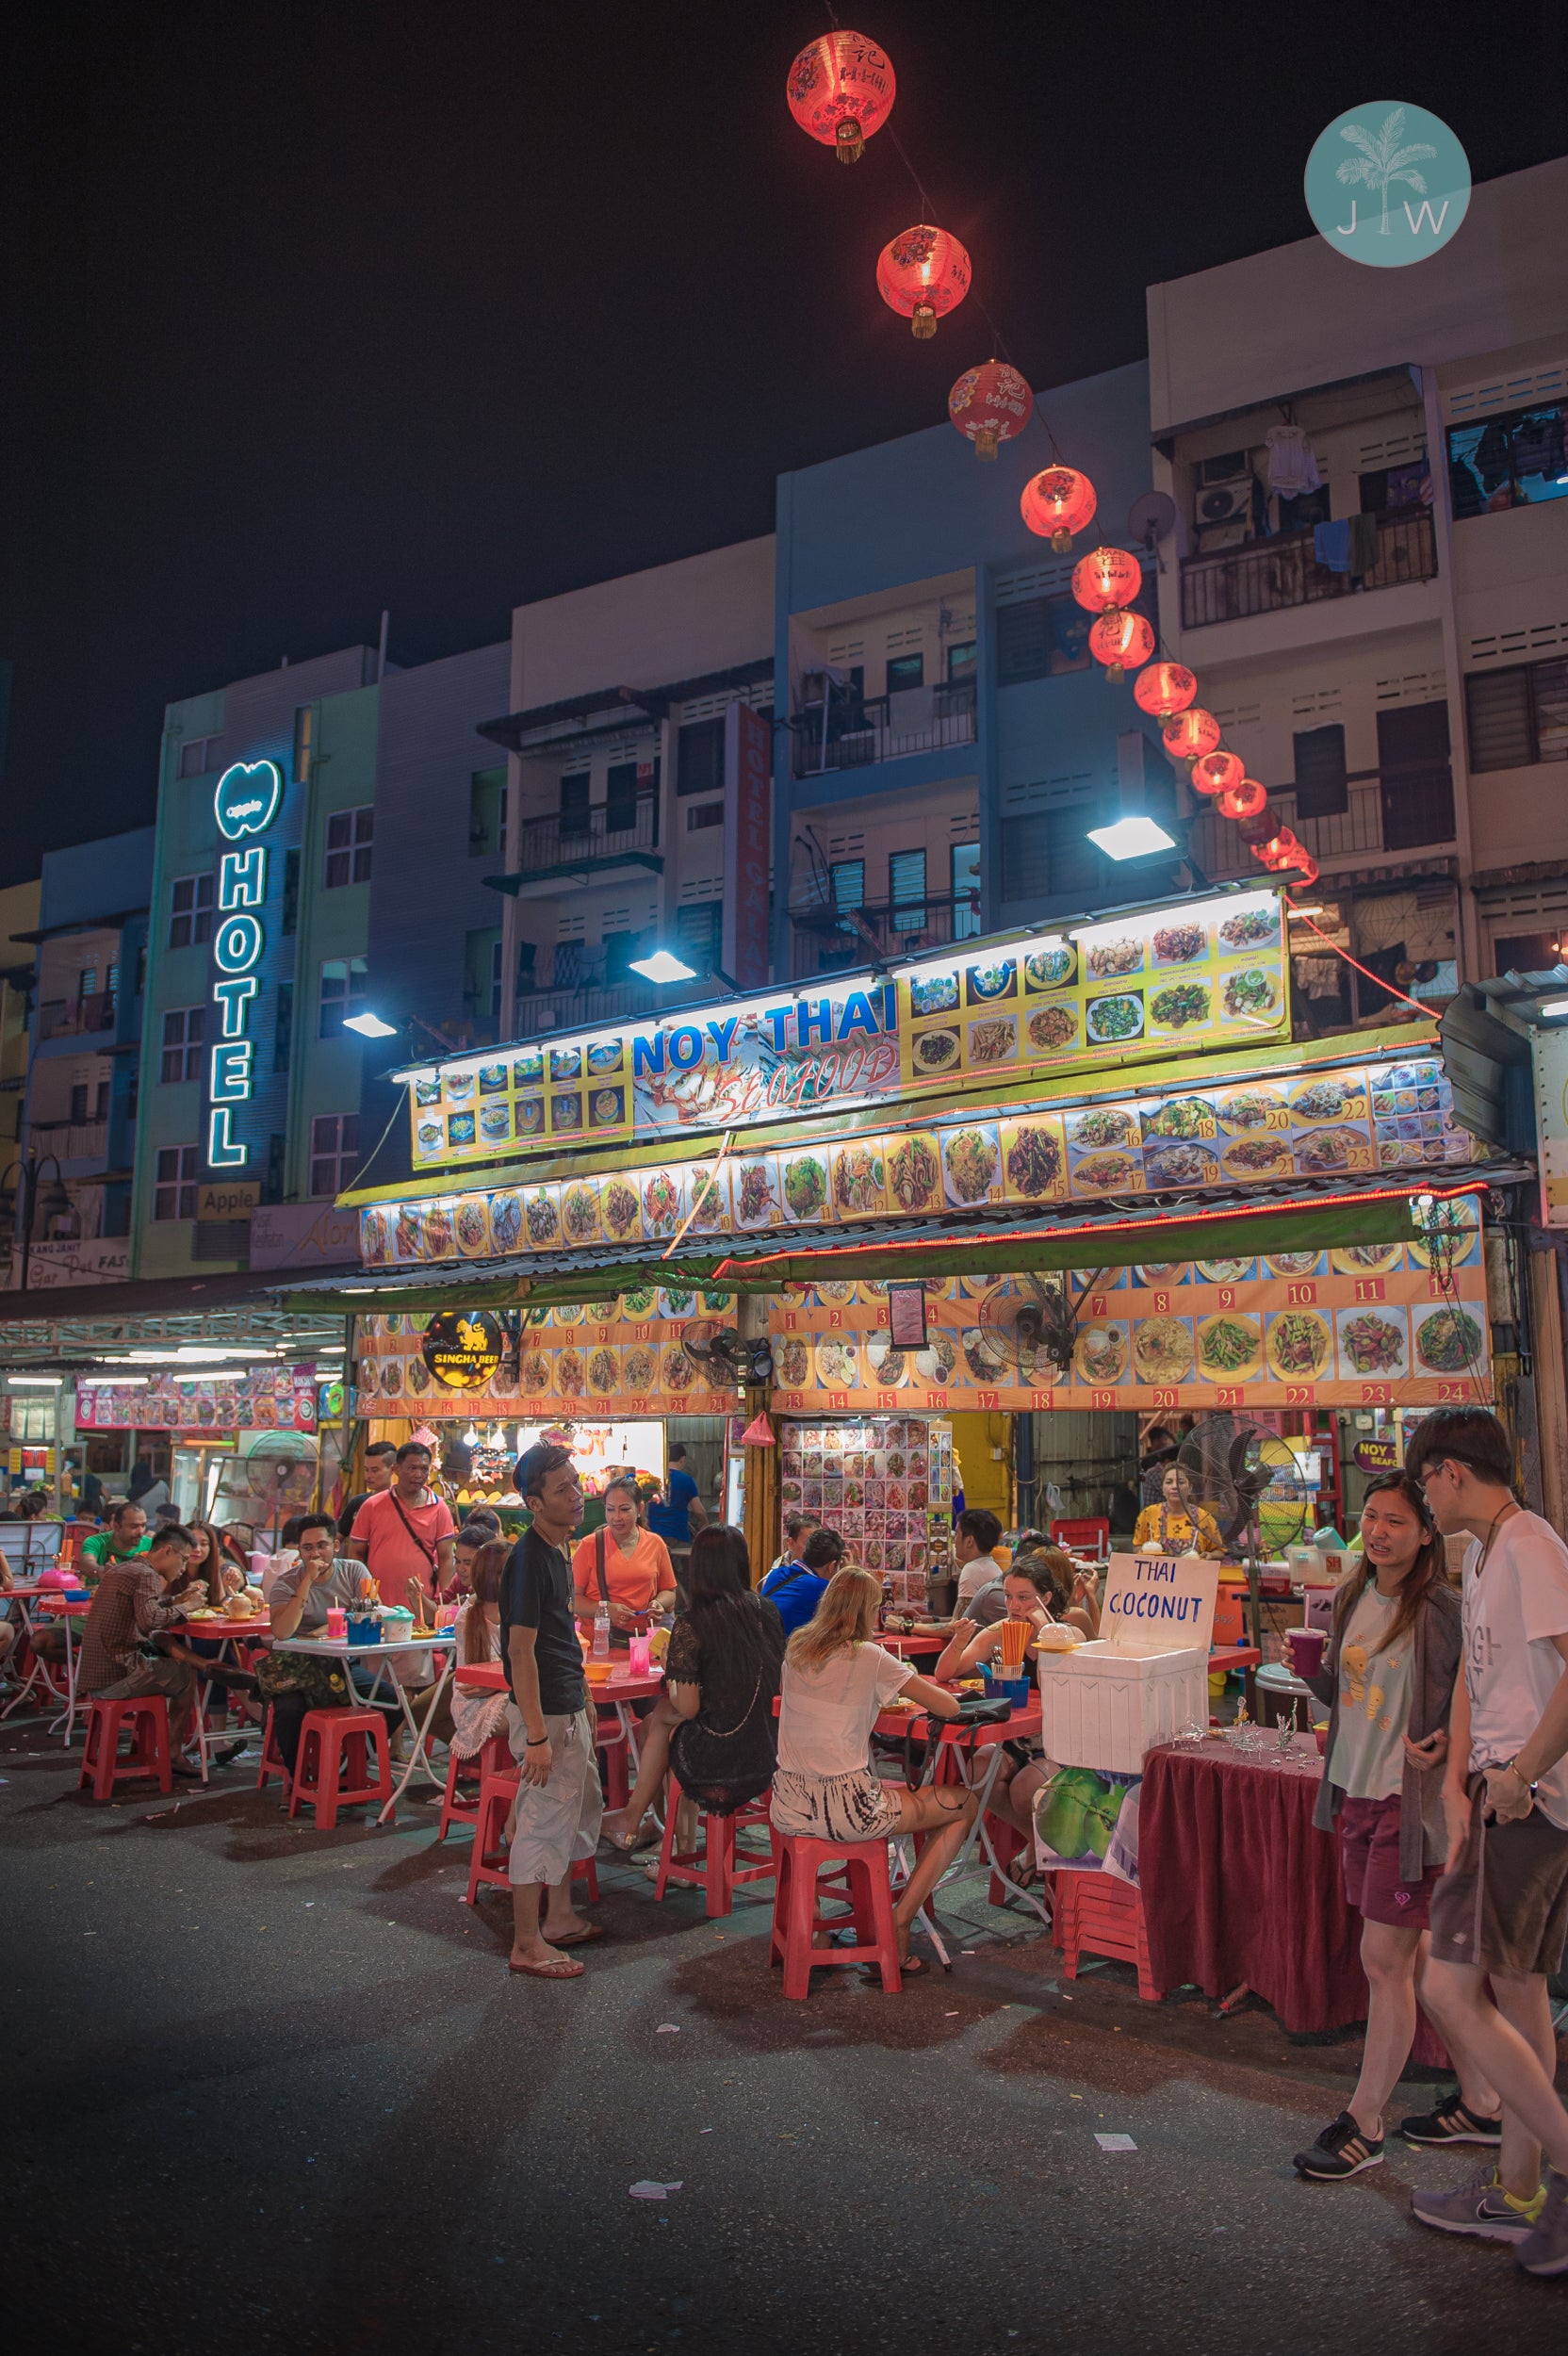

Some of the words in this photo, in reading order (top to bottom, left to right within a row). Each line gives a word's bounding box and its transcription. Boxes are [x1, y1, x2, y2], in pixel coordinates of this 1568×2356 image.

[206, 847, 265, 1168] HOTEL
[633, 1016, 740, 1079] NOY
[765, 984, 899, 1056] THAI
[719, 1043, 897, 1121] SEAFOOD
[1343, 1101, 1366, 1121] 22
[1266, 1111, 1289, 1130] 20
[1198, 1121, 1214, 1137] 18
[1126, 1131, 1140, 1146] 16
[1348, 1148, 1370, 1168] 23
[1204, 1165, 1218, 1181] 19
[1278, 1157, 1296, 1175] 21
[1052, 1179, 1065, 1197] 15
[1129, 1173, 1143, 1188] 17
[204, 1190, 253, 1211] Apple
[929, 1194, 941, 1209] 13
[988, 1187, 1002, 1203] 14
[821, 1205, 831, 1219] 11
[873, 1201, 884, 1215] 12
[720, 1216, 729, 1228] 10
[769, 1210, 780, 1224] 10
[633, 1227, 641, 1238] 8
[676, 1220, 683, 1232] 9
[1357, 1280, 1380, 1301] 11
[1430, 1275, 1454, 1297] 12
[1221, 1289, 1232, 1307] 9
[1289, 1284, 1312, 1304] 10
[980, 1303, 988, 1318] 5
[1094, 1298, 1103, 1316] 7
[1157, 1294, 1167, 1312] 8
[788, 1315, 793, 1329] 1
[832, 1311, 841, 1326] 2
[879, 1308, 887, 1324] 3
[928, 1307, 937, 1322] 4
[566, 1330, 573, 1343] 8
[599, 1327, 606, 1341] 9
[637, 1325, 648, 1340] 10
[671, 1323, 681, 1337] 11
[368, 1340, 372, 1351] 1
[390, 1339, 396, 1351] 2
[416, 1338, 422, 1350] 3
[534, 1333, 541, 1346] 7
[433, 1353, 477, 1365] SINGHA
[479, 1354, 499, 1365] BEER
[1153, 1390, 1175, 1407] 20
[1217, 1389, 1237, 1405] 21
[1286, 1387, 1309, 1403] 22
[1363, 1385, 1385, 1402] 23
[1439, 1383, 1464, 1401] 24
[414, 1401, 422, 1414] 15
[443, 1401, 451, 1413] 16
[470, 1401, 480, 1414] 17
[498, 1401, 507, 1414] 18
[530, 1401, 541, 1414] 19
[563, 1401, 574, 1414] 20
[596, 1401, 608, 1413] 21
[632, 1400, 645, 1414] 22
[671, 1399, 683, 1413] 23
[710, 1398, 723, 1413] 24
[786, 1393, 800, 1409] 13
[829, 1394, 845, 1409] 14
[878, 1393, 893, 1408] 15
[927, 1393, 944, 1408] 16
[979, 1392, 995, 1408] 17
[1032, 1393, 1050, 1409] 18
[1093, 1391, 1112, 1409] 19
[1359, 1443, 1388, 1457] NOY
[1326, 1556, 1342, 1567] SH
[1135, 1560, 1176, 1583] THAI
[1109, 1592, 1202, 1623] COCONUT
